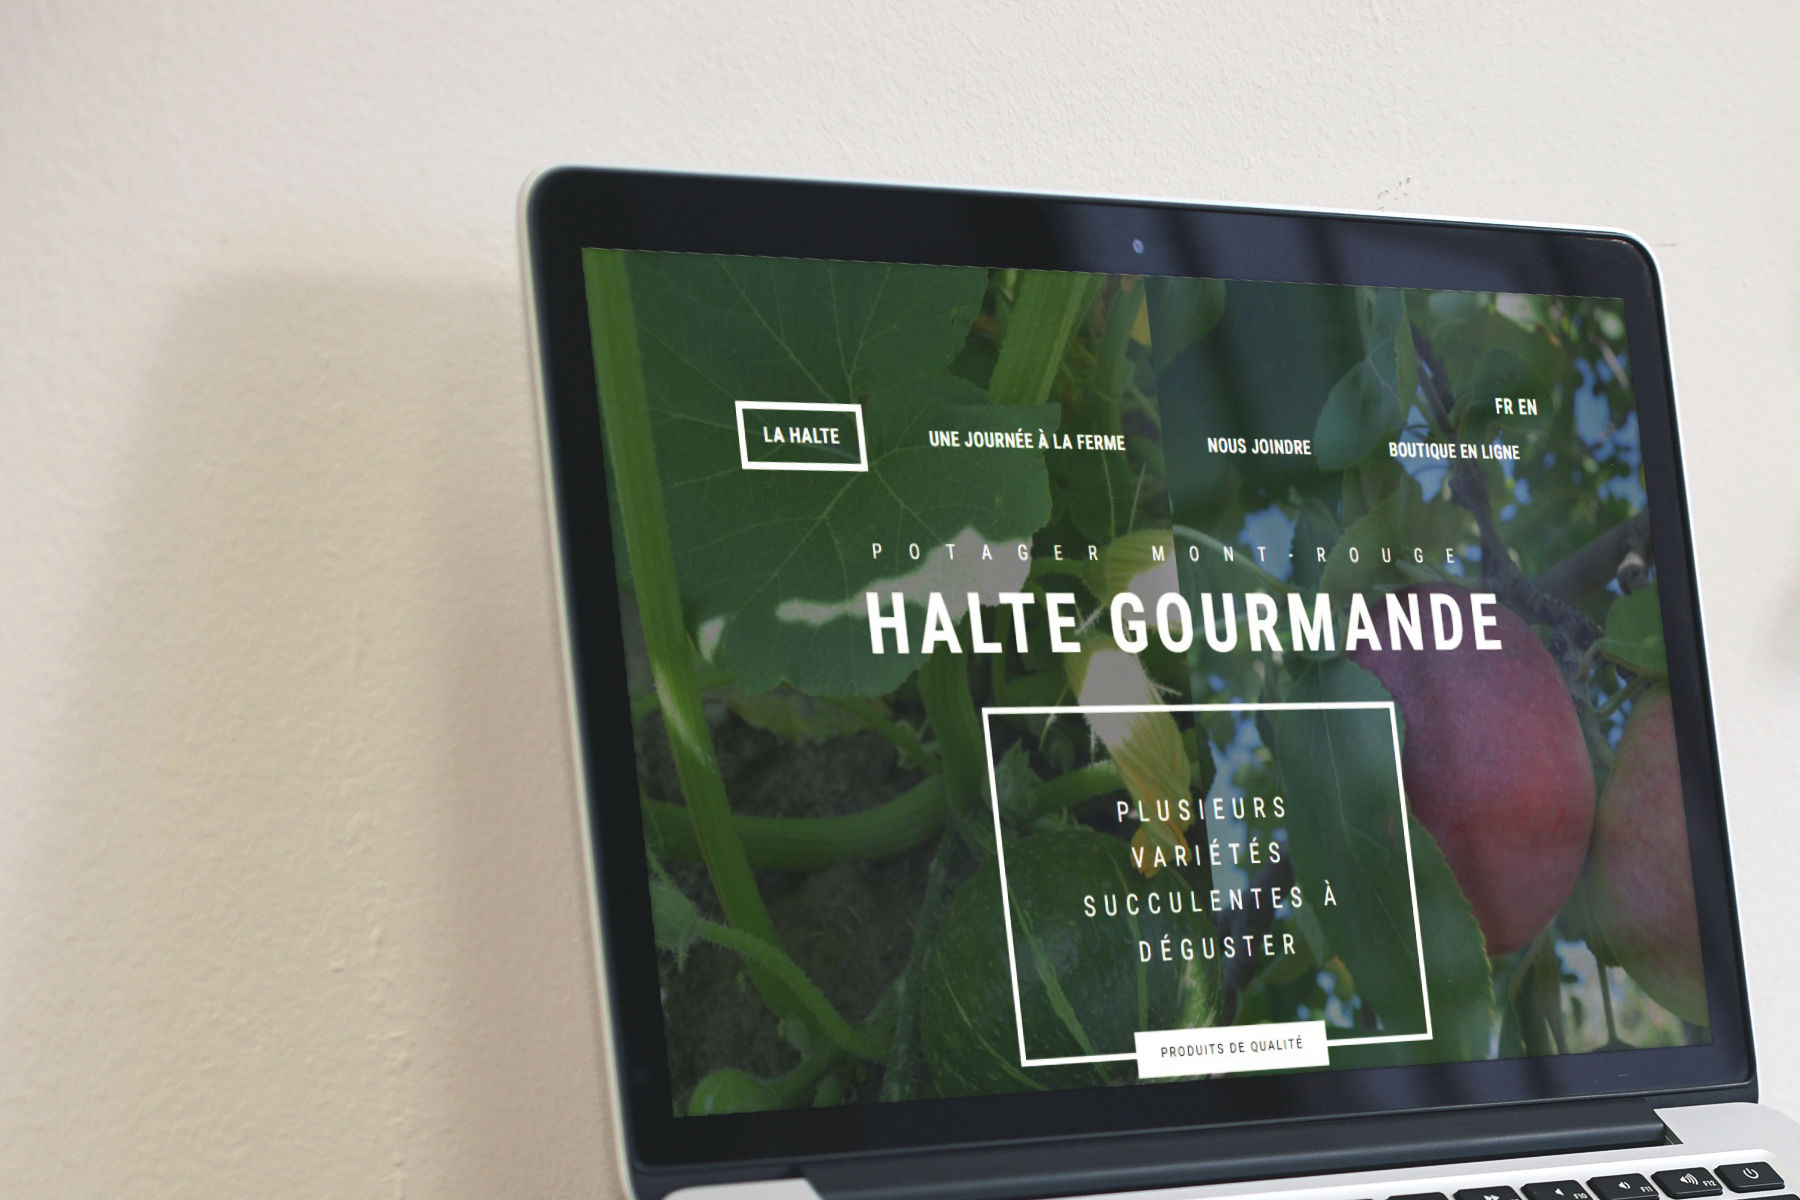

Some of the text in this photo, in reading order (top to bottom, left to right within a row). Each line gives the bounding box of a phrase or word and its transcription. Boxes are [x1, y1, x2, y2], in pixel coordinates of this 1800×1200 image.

[1495, 397, 1538, 416] FR EN
[763, 425, 840, 445] LA HALTE
[929, 428, 1126, 451] UNE JOURNÉE À LA FERME
[1207, 437, 1311, 456] NOUS JOINDRE
[1389, 442, 1520, 461] BOUTIQUE EN LIGNE
[872, 543, 1455, 565] POTAGER MONT-ROUGE
[866, 591, 1502, 655] HALTE GOURMANDE
[1117, 796, 1286, 823] PLUSIEURS
[1131, 837, 1281, 869] VARIÉTÉS
[1084, 880, 1337, 918] SUCCULENTES À
[1138, 933, 1295, 962] DÉGUSTER
[1161, 1035, 1302, 1057] PRODUITS DE QUALITÉ
[1641, 1183, 1655, 1192] F11
[1703, 1178, 1718, 1186] F12
[1574, 1190, 1589, 1199] F10
